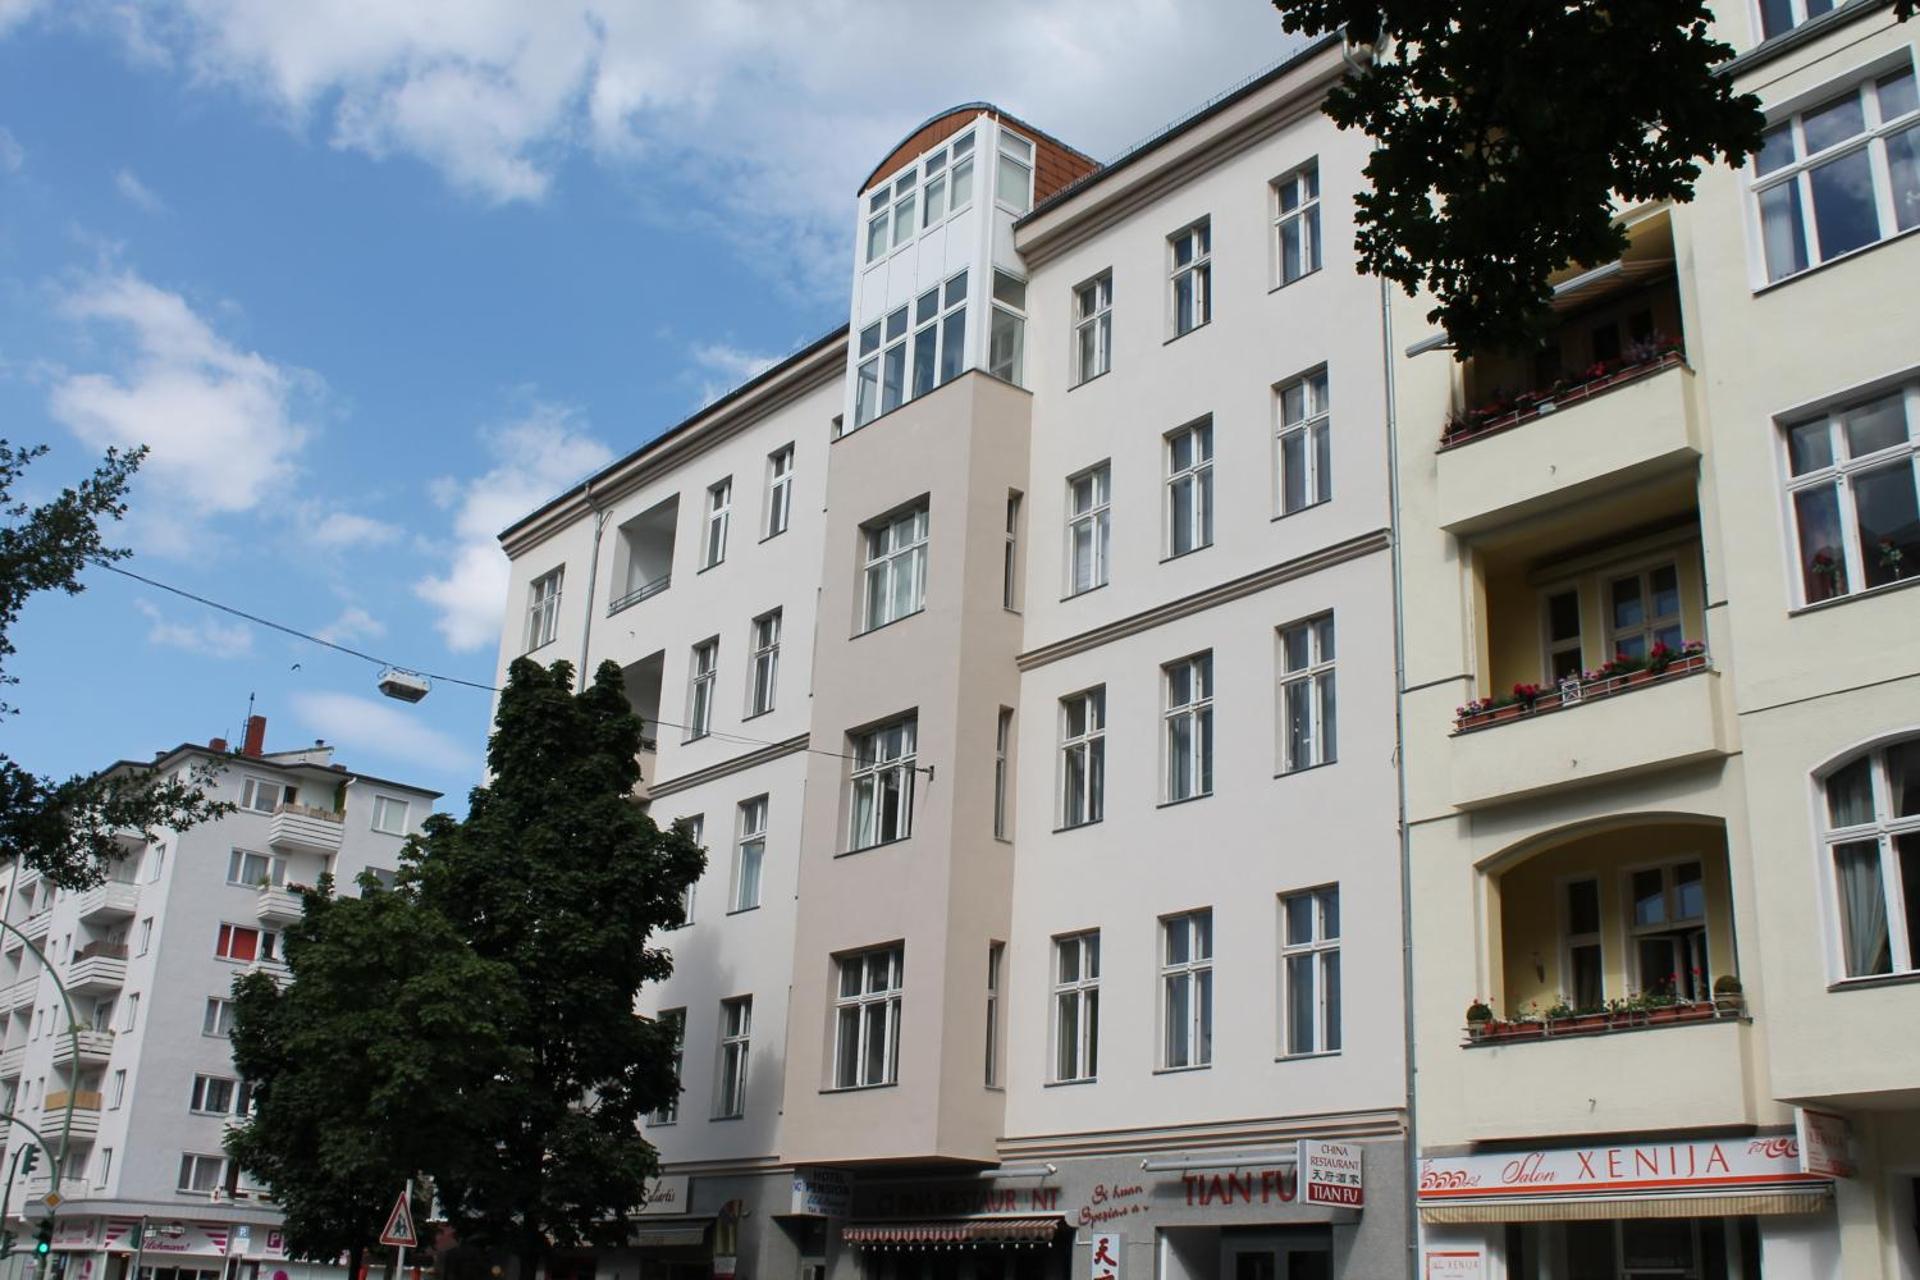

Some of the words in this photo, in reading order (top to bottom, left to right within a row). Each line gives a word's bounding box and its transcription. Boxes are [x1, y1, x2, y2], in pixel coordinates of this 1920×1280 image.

[1321, 1144, 1349, 1156] CHINA
[1310, 1156, 1360, 1170] RESTAURANT
[1502, 1152, 1559, 1184] Salon
[1577, 1143, 1730, 1180] XENIJA
[1182, 1171, 1252, 1206] TIAN
[1261, 1167, 1298, 1204] FU
[1312, 1184, 1341, 1201] TIAN
[1343, 1188, 1359, 1203] FU
